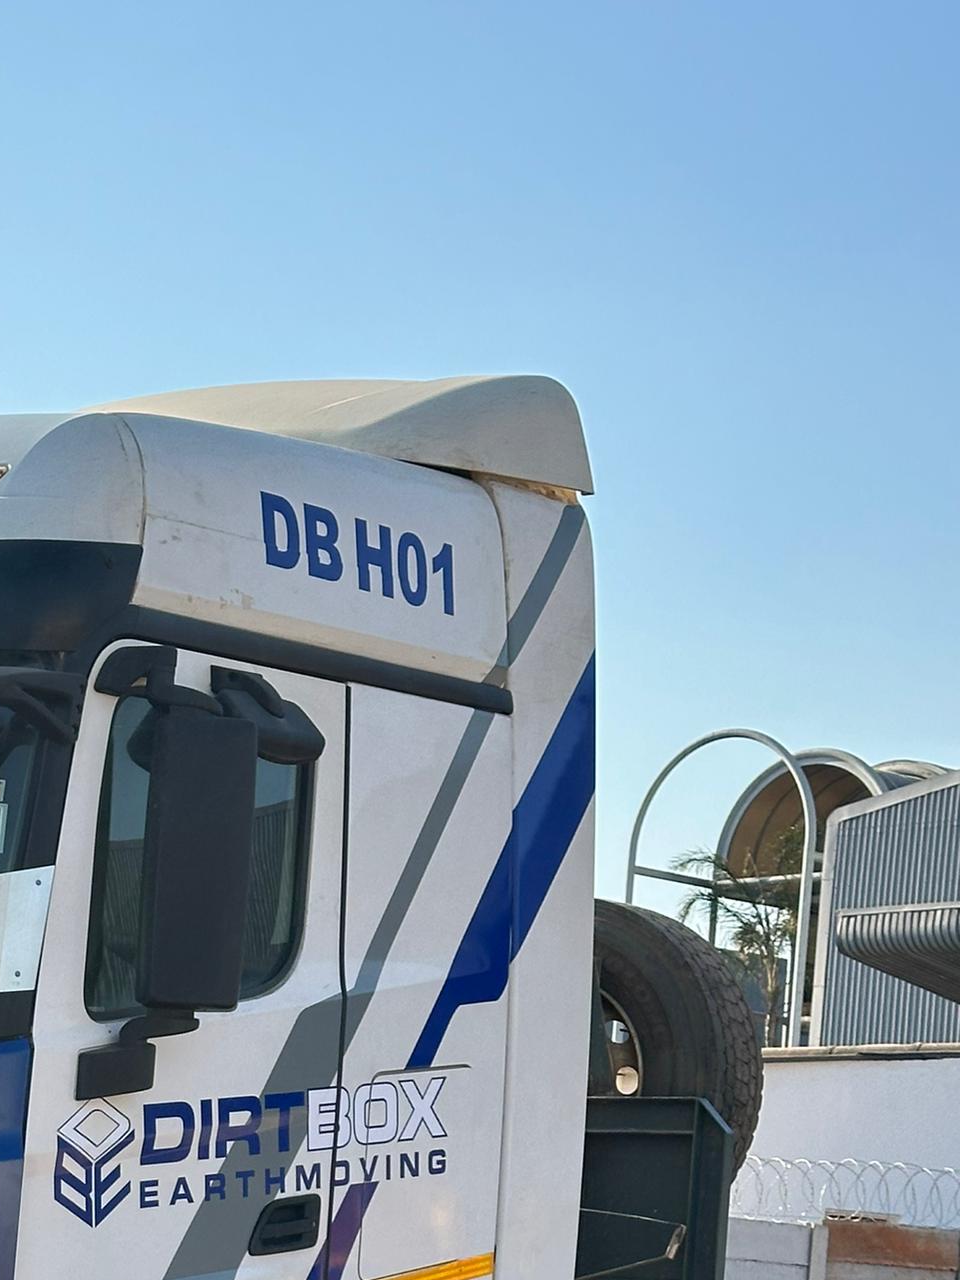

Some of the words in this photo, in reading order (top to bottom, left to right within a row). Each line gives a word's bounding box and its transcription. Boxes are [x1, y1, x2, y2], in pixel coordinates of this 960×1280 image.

[260, 490, 343, 581] DB
[355, 517, 454, 616] H01
[139, 1076, 448, 1165] DIRTBOX
[139, 1149, 447, 1209] EARTHMOVING
